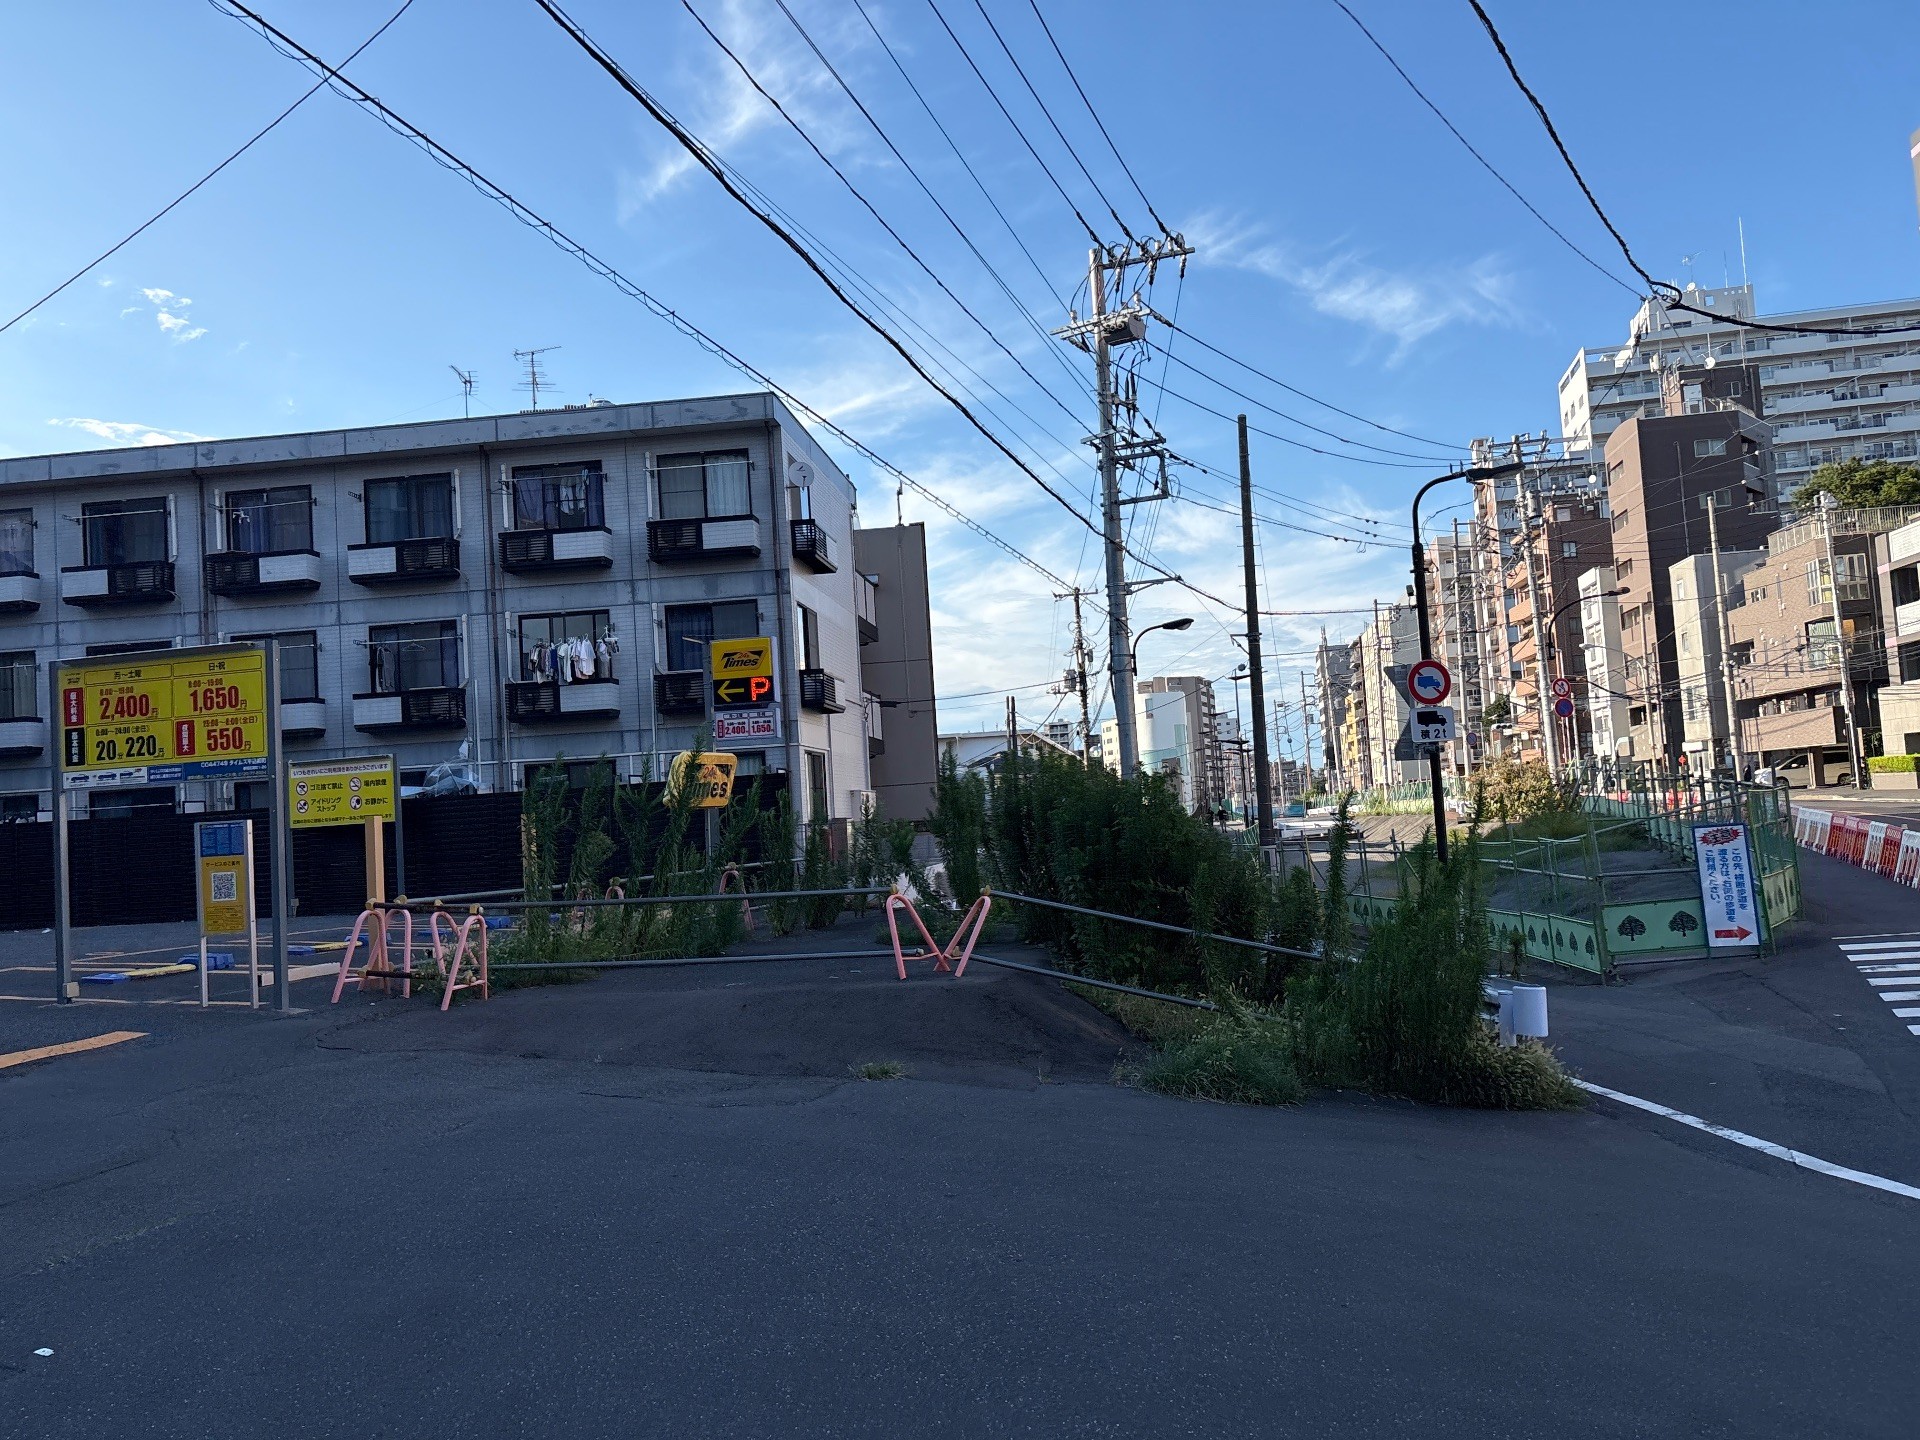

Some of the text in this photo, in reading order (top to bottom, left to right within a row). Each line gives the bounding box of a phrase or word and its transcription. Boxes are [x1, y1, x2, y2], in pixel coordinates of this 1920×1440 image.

[723, 657, 760, 669] Times
[750, 676, 770, 701] P
[310, 783, 343, 791] ゴミ捨て禁止
[310, 797, 388, 806] アイドリング お静かに
[316, 805, 337, 813] ストップ
